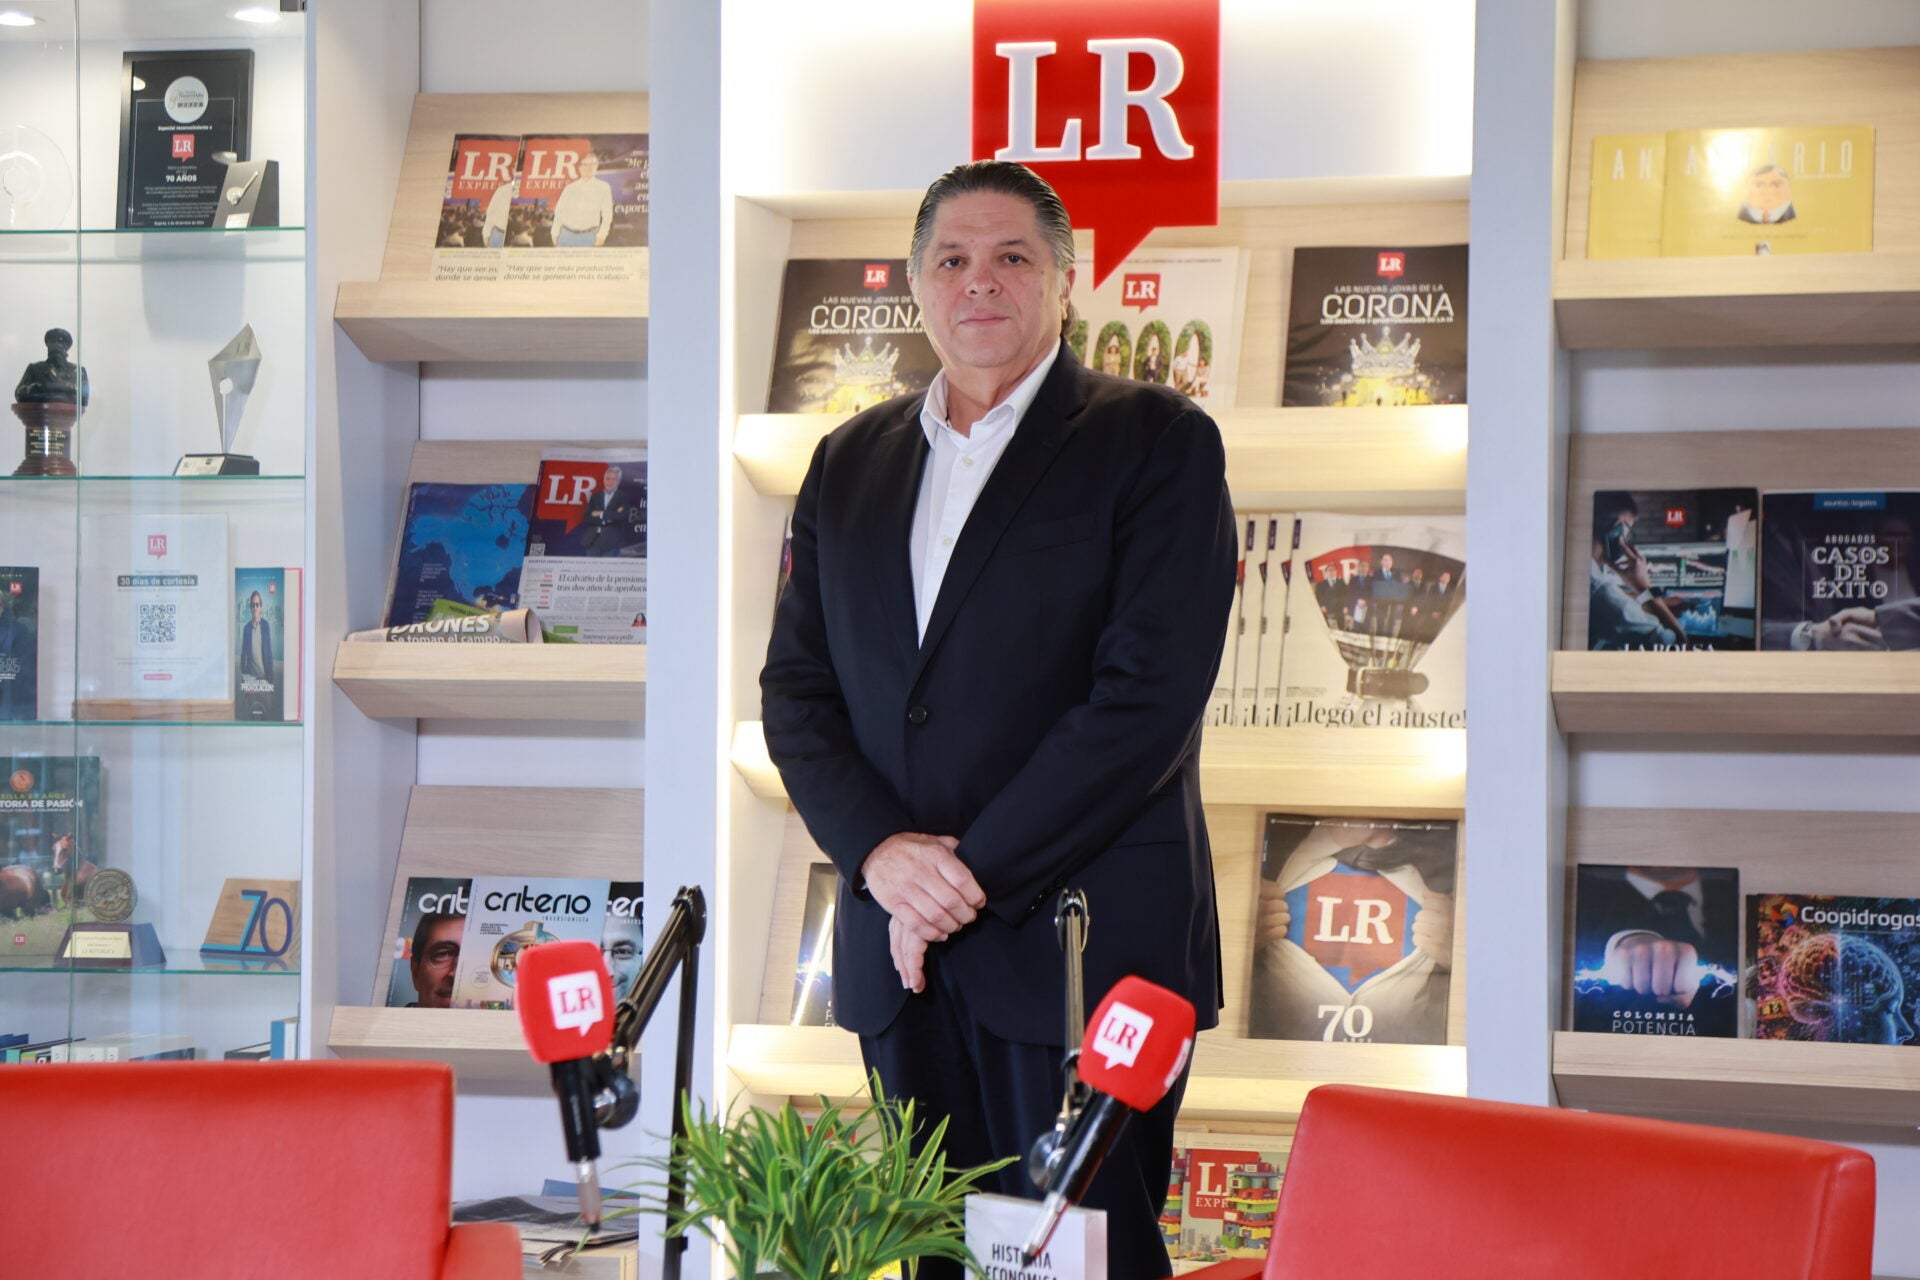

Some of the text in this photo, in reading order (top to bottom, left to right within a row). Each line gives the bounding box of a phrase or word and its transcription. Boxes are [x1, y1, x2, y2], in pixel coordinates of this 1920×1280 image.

[994, 37, 1194, 162] LR
[174, 140, 192, 153] LR
[460, 151, 513, 182] LR
[527, 150, 579, 180] LR
[1379, 257, 1402, 271] LR
[865, 270, 886, 283] LR
[1125, 280, 1156, 299] LR
[1321, 292, 1454, 319] CORONA
[544, 474, 597, 505] LR
[1667, 510, 1683, 523] LR
[149, 537, 166, 550] LR
[1811, 546, 1890, 565] CASOS
[120, 575, 195, 586] 30 días de cortesía
[1834, 563, 1867, 581] DE
[1812, 577, 1889, 599] ÉXITO
[1362, 703, 1382, 726] el
[30, 799, 45, 808] DE
[484, 885, 591, 915] criterio
[1313, 895, 1394, 945] LR
[557, 986, 597, 1014] LR
[1317, 1004, 1373, 1042] 70
[1613, 1010, 1695, 1021] COLOMBIA
[1102, 1017, 1138, 1051] LR
[1612, 1019, 1696, 1036] POTENCIA
